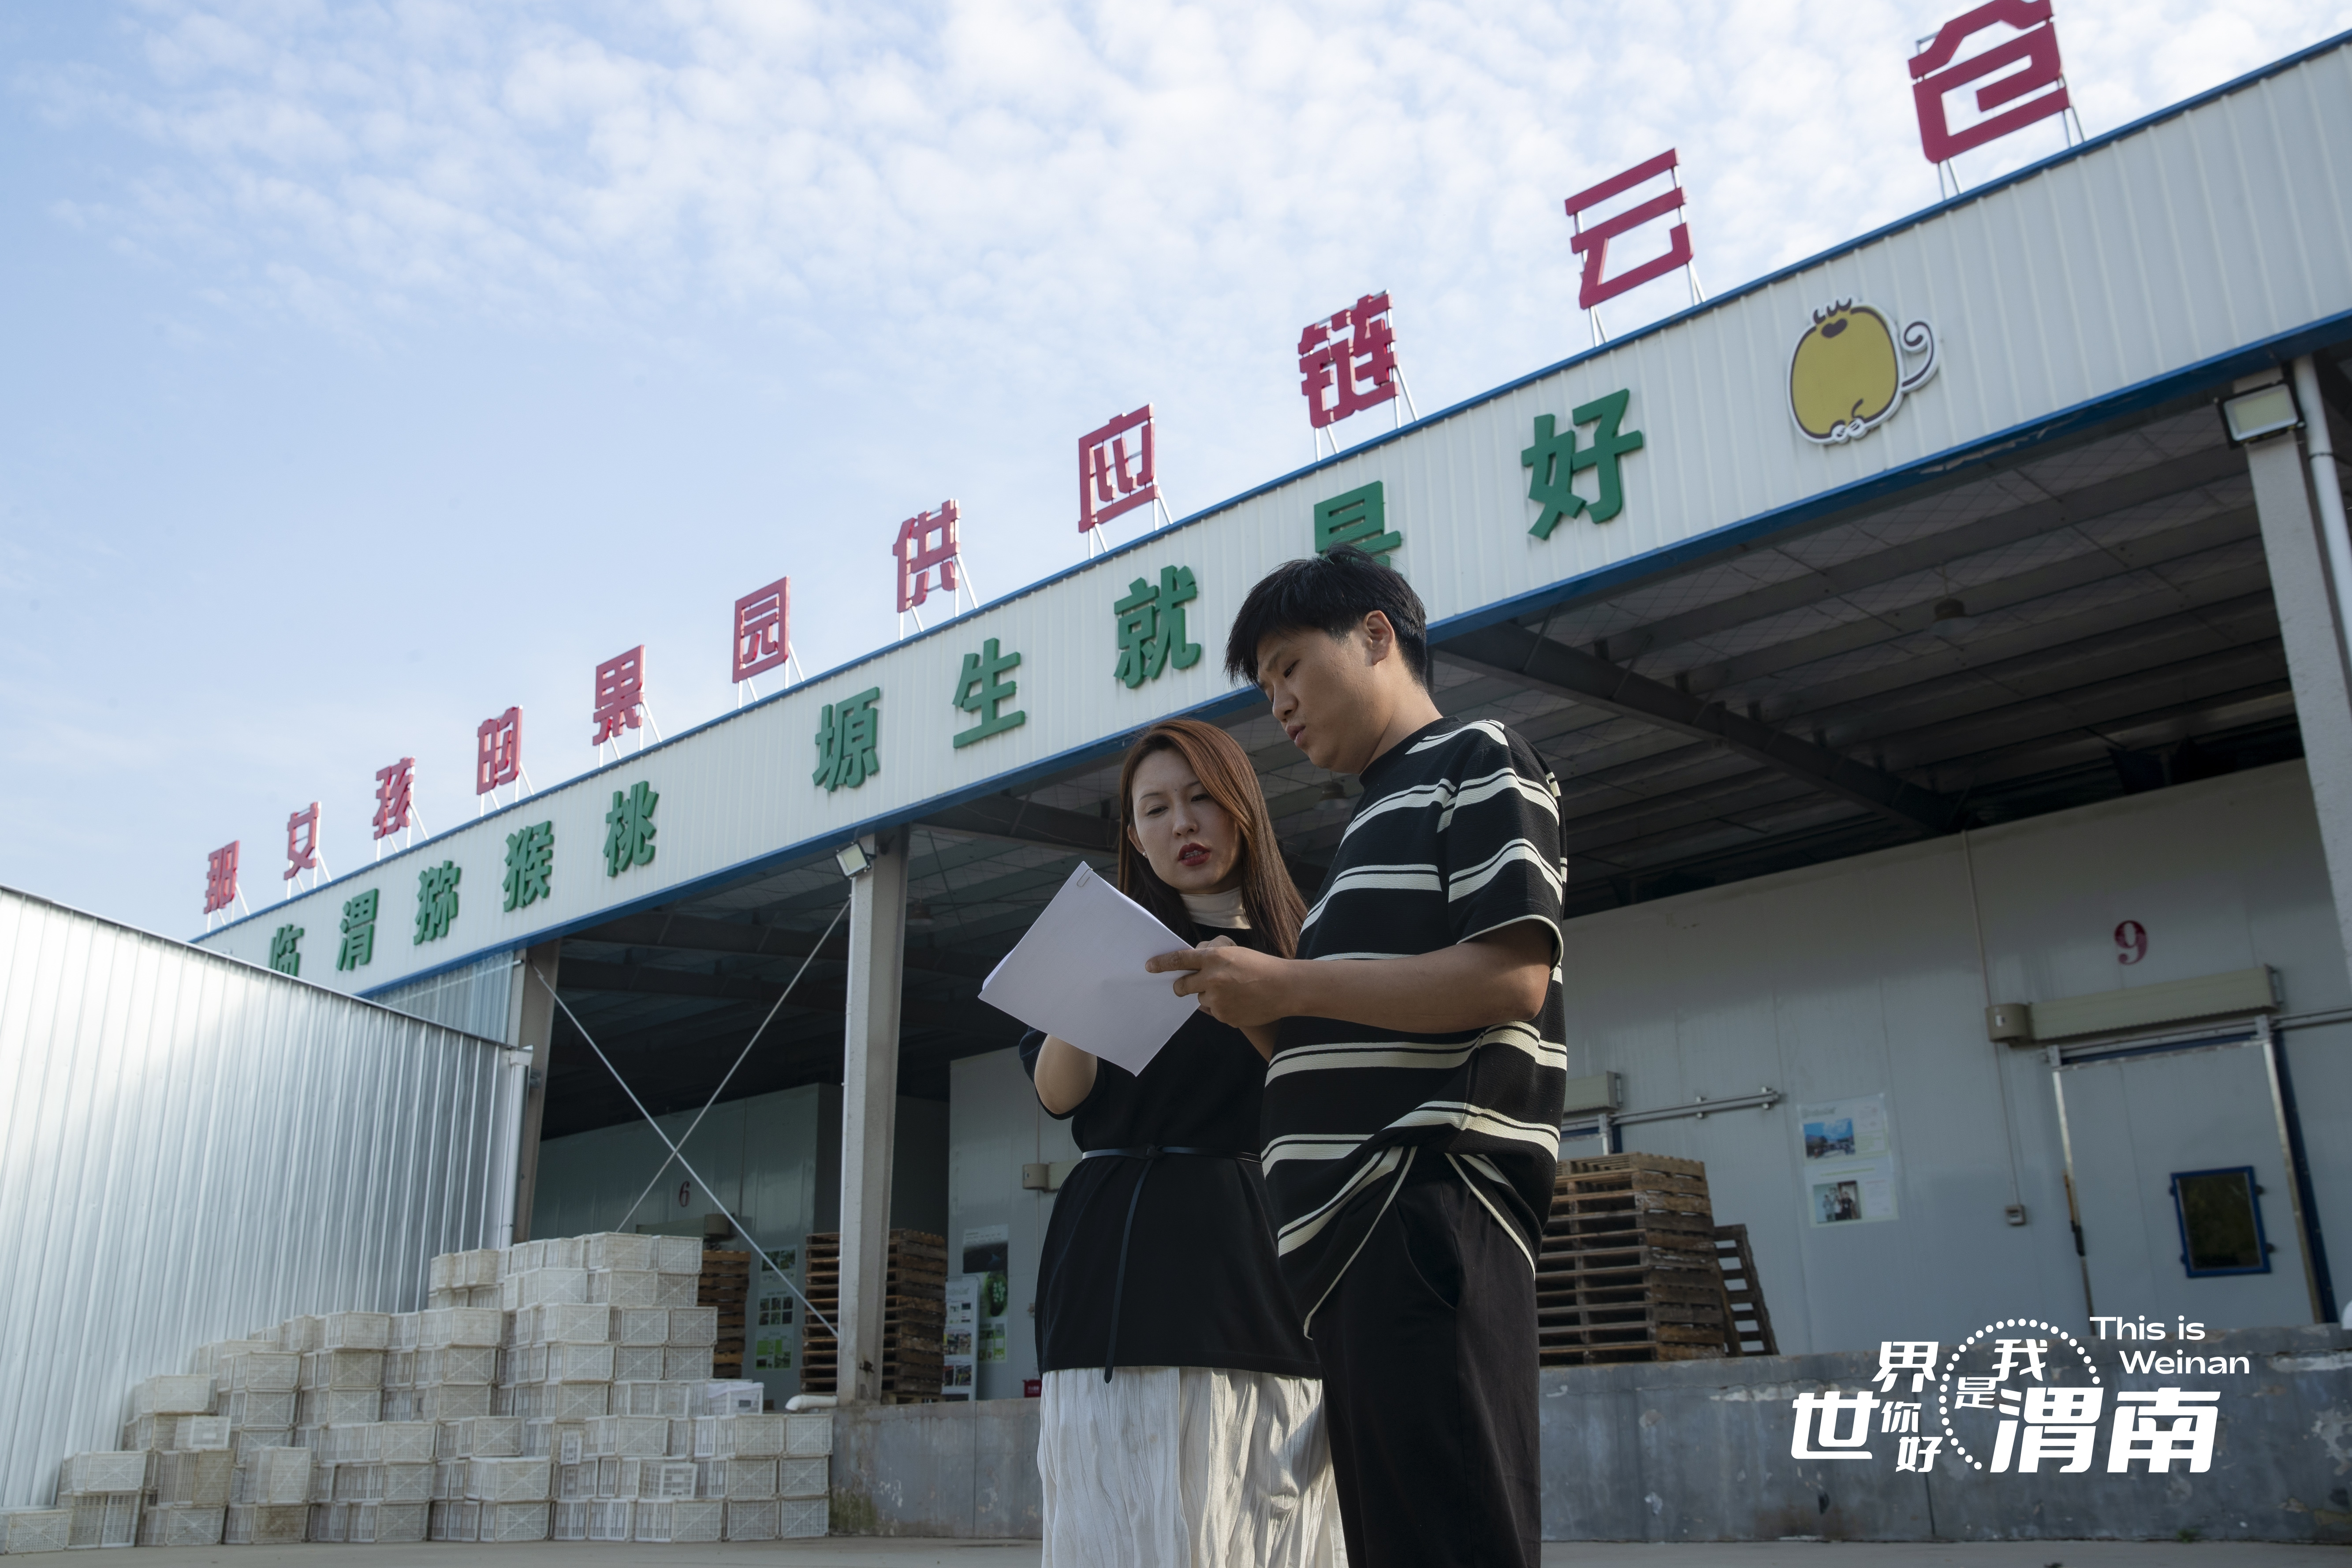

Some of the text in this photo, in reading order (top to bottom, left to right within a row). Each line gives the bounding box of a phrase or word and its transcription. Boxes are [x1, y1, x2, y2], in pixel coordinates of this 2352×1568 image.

[204, 0, 2072, 914] 那女孩的果园供应链云仓
[268, 781, 659, 977] 临渭猕猴桃
[2114, 920, 2147, 965] 9
[679, 1181, 690, 1207] 6
